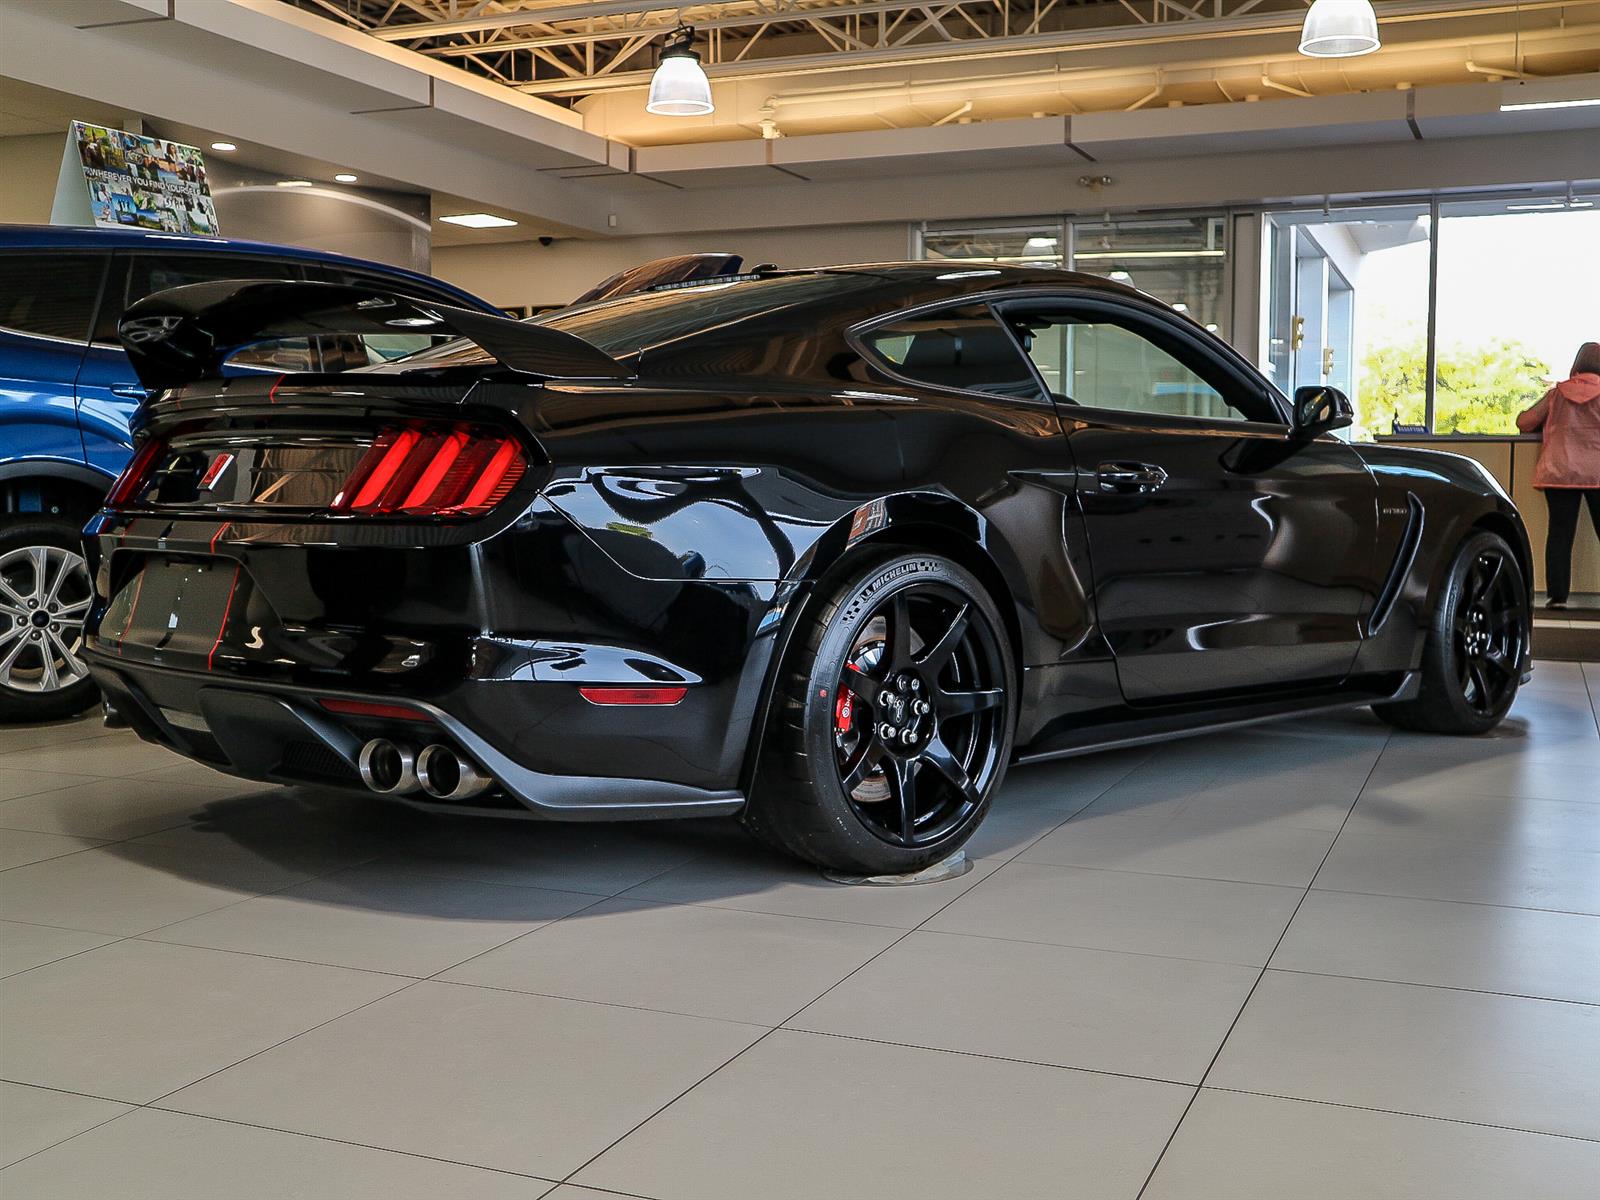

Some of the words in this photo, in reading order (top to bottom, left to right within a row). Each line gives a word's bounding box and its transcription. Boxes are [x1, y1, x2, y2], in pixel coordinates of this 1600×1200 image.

[90, 168, 132, 183] WHEREVER
[132, 177, 148, 187] YOU
[149, 180, 166, 190] FIND
[872, 562, 918, 590] MICHELIN
